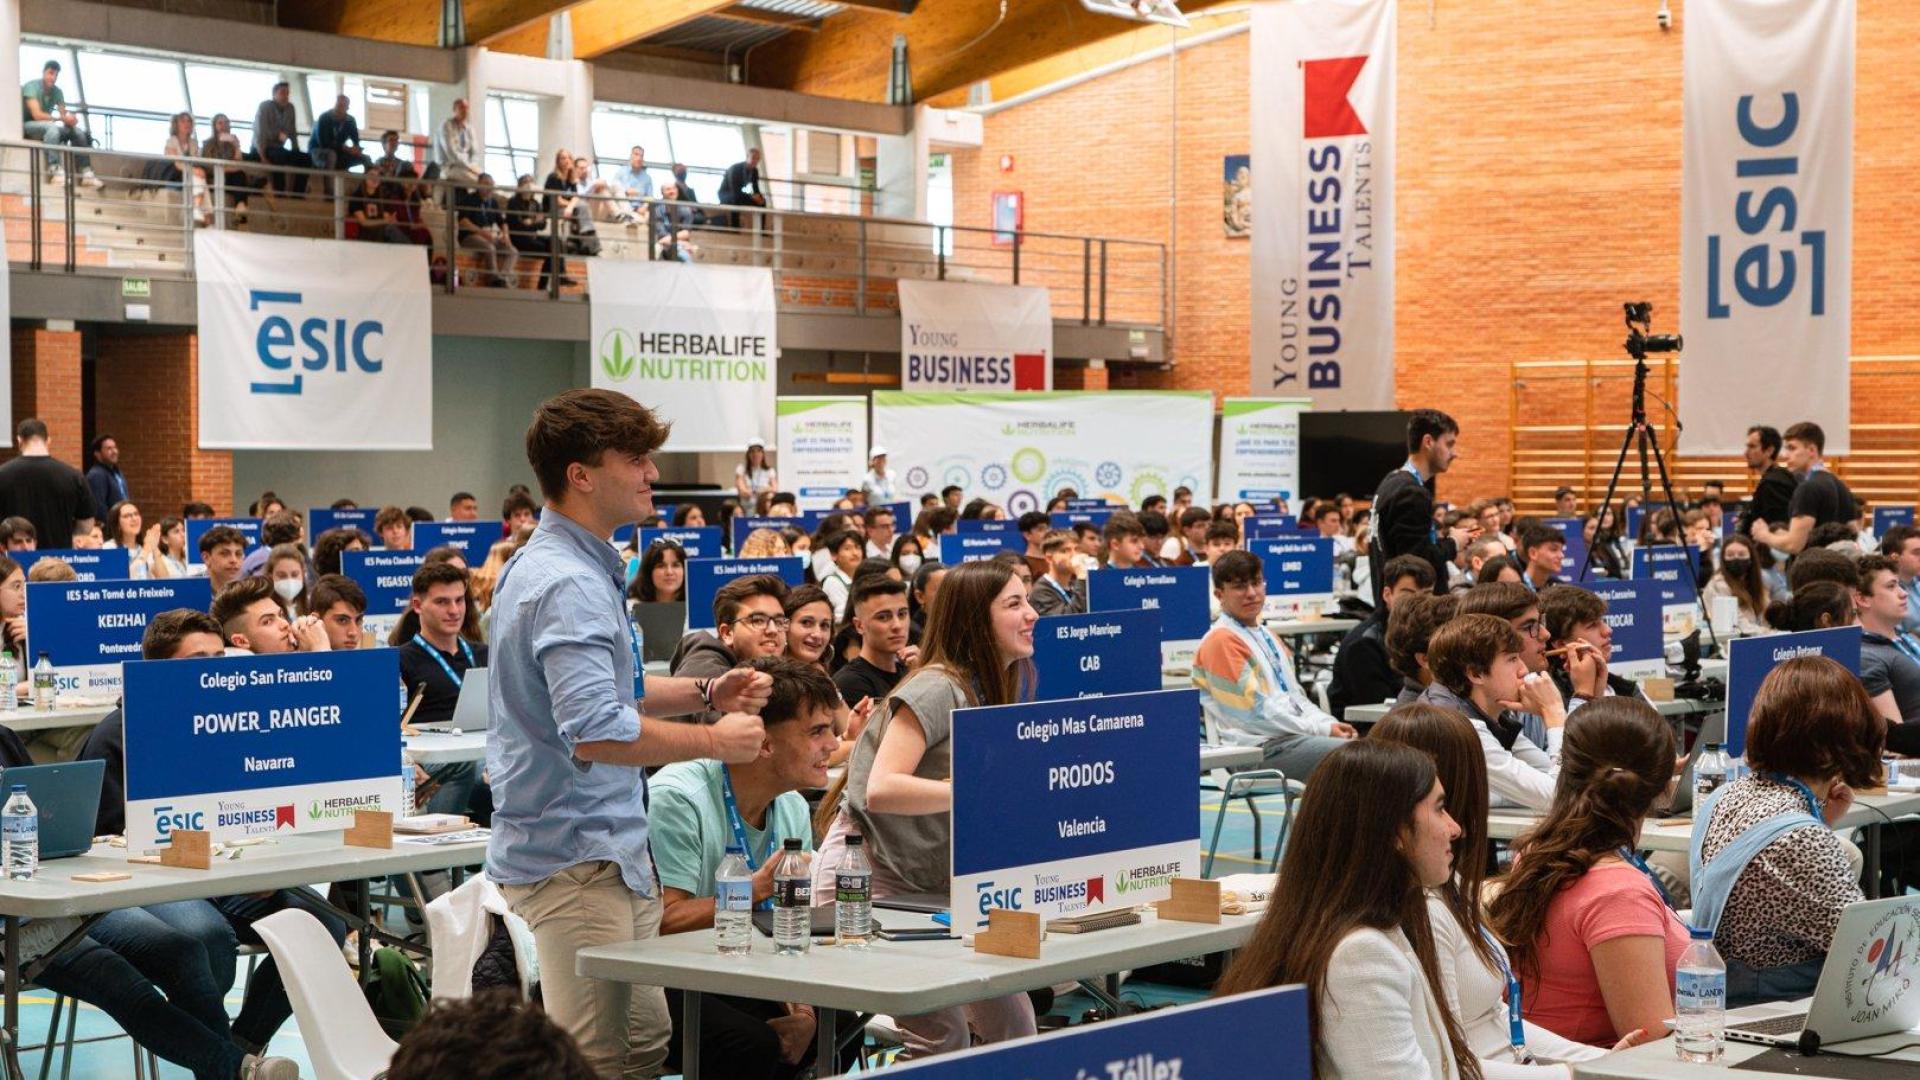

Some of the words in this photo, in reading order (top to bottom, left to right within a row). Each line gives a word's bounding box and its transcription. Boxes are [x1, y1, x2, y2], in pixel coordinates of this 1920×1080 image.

[1347, 143, 1372, 278] TALENTS
[1308, 145, 1341, 389] BUSINESS
[640, 332, 766, 357] HERBALIFE
[909, 325, 958, 347] YOUNG
[1274, 278, 1297, 389] YOUNG
[640, 358, 767, 382] NUTRITION
[909, 354, 1011, 384] BUSINESS
[66, 590, 81, 601] IES
[83, 590, 100, 600] San
[98, 614, 146, 628] KEIZHAI
[1056, 626, 1069, 639] IES
[1089, 623, 1122, 638] Manrique
[100, 642, 143, 654] Pontevedr
[1080, 655, 1100, 672] CAB
[89, 677, 121, 687] BUSINES
[200, 672, 247, 691] Colegio
[250, 670, 274, 686] San
[277, 666, 333, 684] Francisco
[193, 705, 341, 735] POWER_RANGER
[1017, 719, 1059, 742] Colegio
[1062, 717, 1087, 735] Mas
[1089, 714, 1145, 732] Camarena
[244, 756, 295, 772] Navarra
[1049, 760, 1115, 791] PRODOS
[218, 801, 245, 811] YOUNG
[324, 794, 380, 808] HERBALIFE
[218, 809, 276, 827] BUSINESS
[1058, 816, 1106, 838] Valencia
[1130, 861, 1180, 879] HERBALIFE
[1035, 882, 1086, 904] BUSINESS
